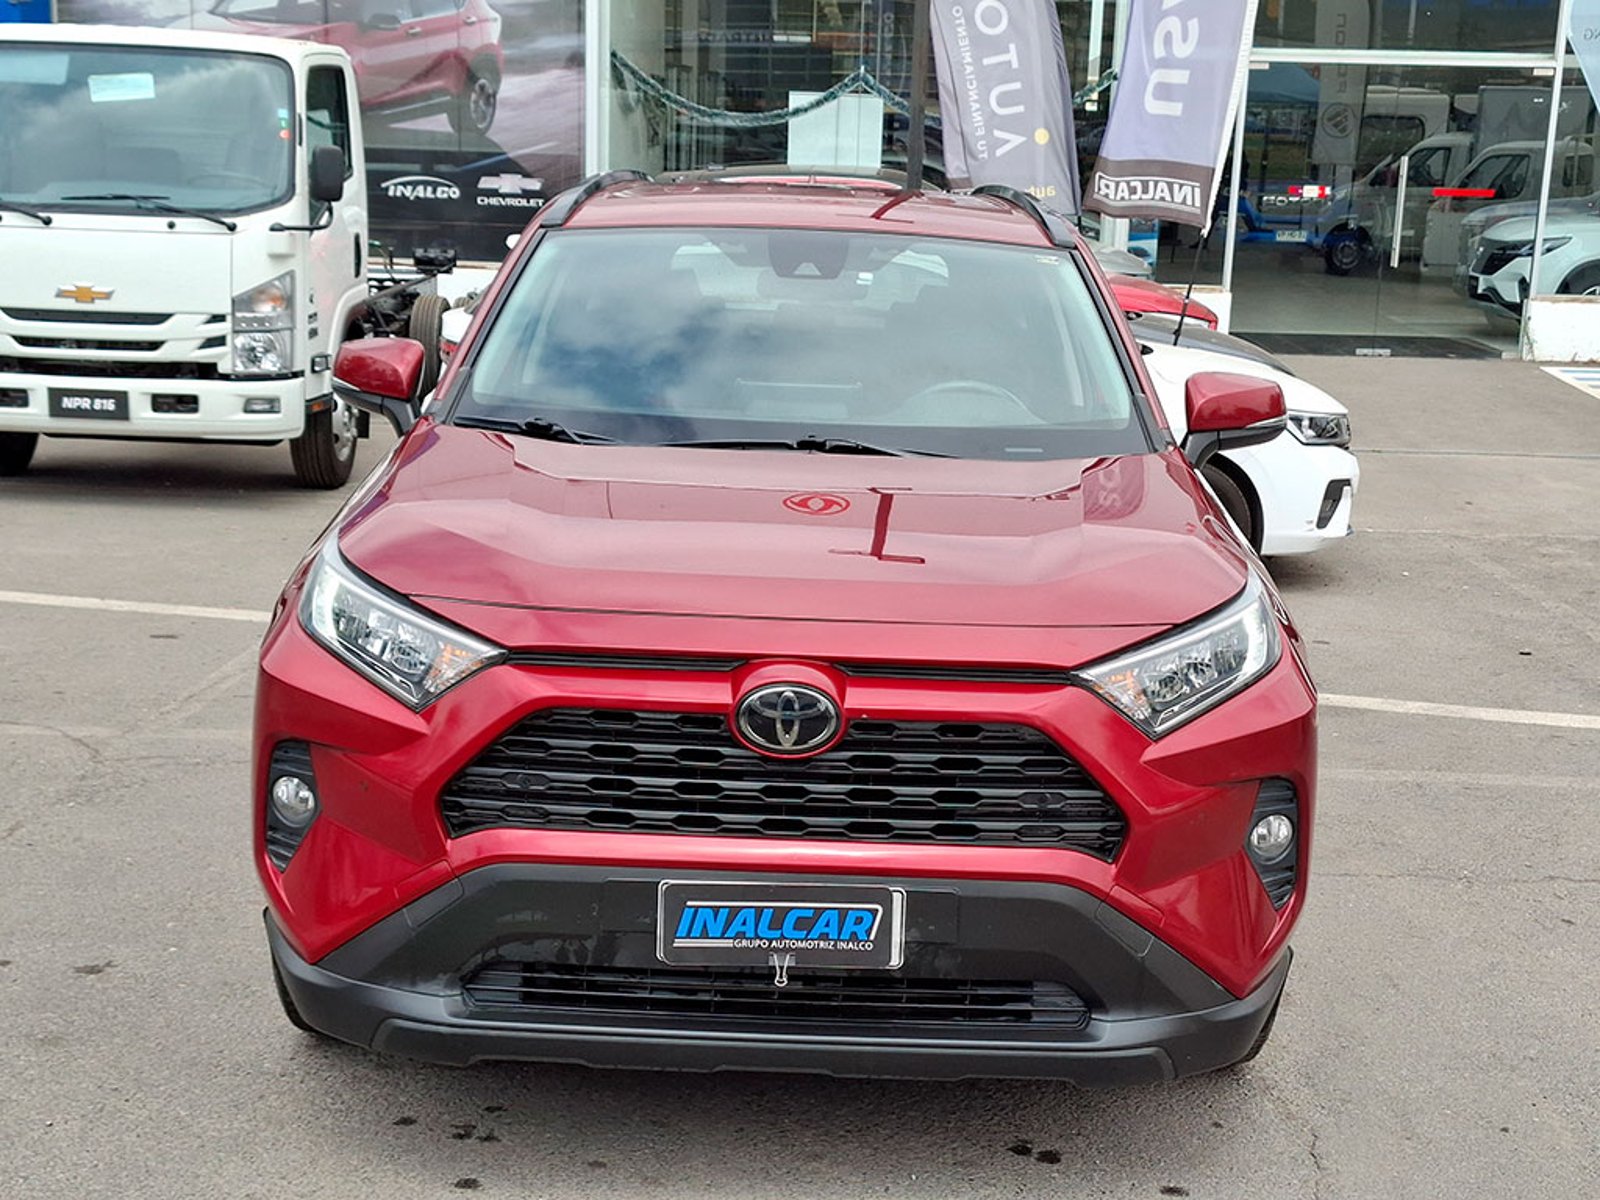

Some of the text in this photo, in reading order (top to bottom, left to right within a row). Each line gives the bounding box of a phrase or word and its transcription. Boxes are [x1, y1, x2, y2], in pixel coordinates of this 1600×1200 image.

[387, 184, 461, 200] INALCO
[476, 196, 544, 207] CHEVROLET
[61, 396, 92, 411] NPR
[675, 907, 874, 941] INALCAR
[733, 938, 874, 951] GRUPO AUTOMOTRIZ INALCO
